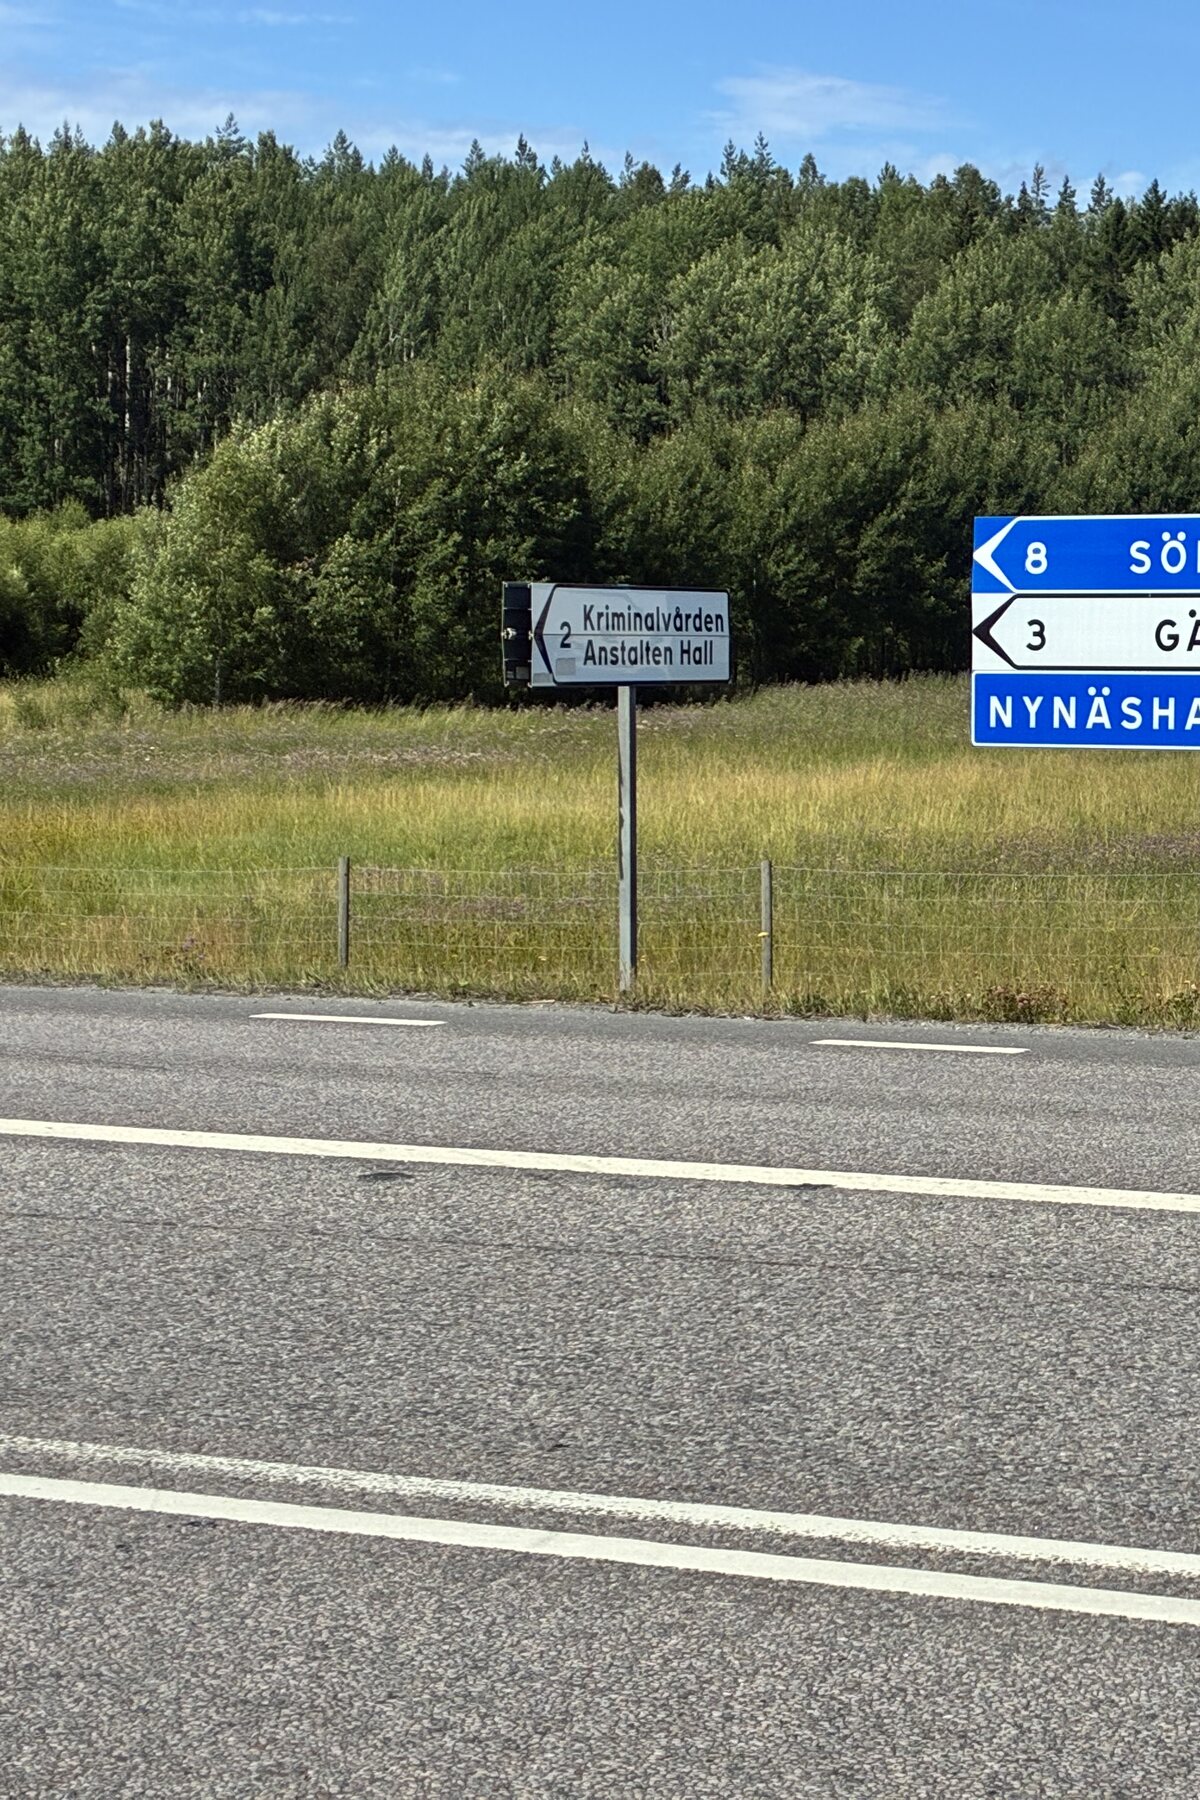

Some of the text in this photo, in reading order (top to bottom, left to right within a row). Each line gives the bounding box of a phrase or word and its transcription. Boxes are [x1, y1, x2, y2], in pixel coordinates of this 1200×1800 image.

[1025, 541, 1048, 575] 8
[583, 604, 724, 632] Kriminalvården
[559, 621, 572, 649] 2
[1026, 619, 1046, 652] 3
[583, 639, 713, 666] Anstalten Hall
